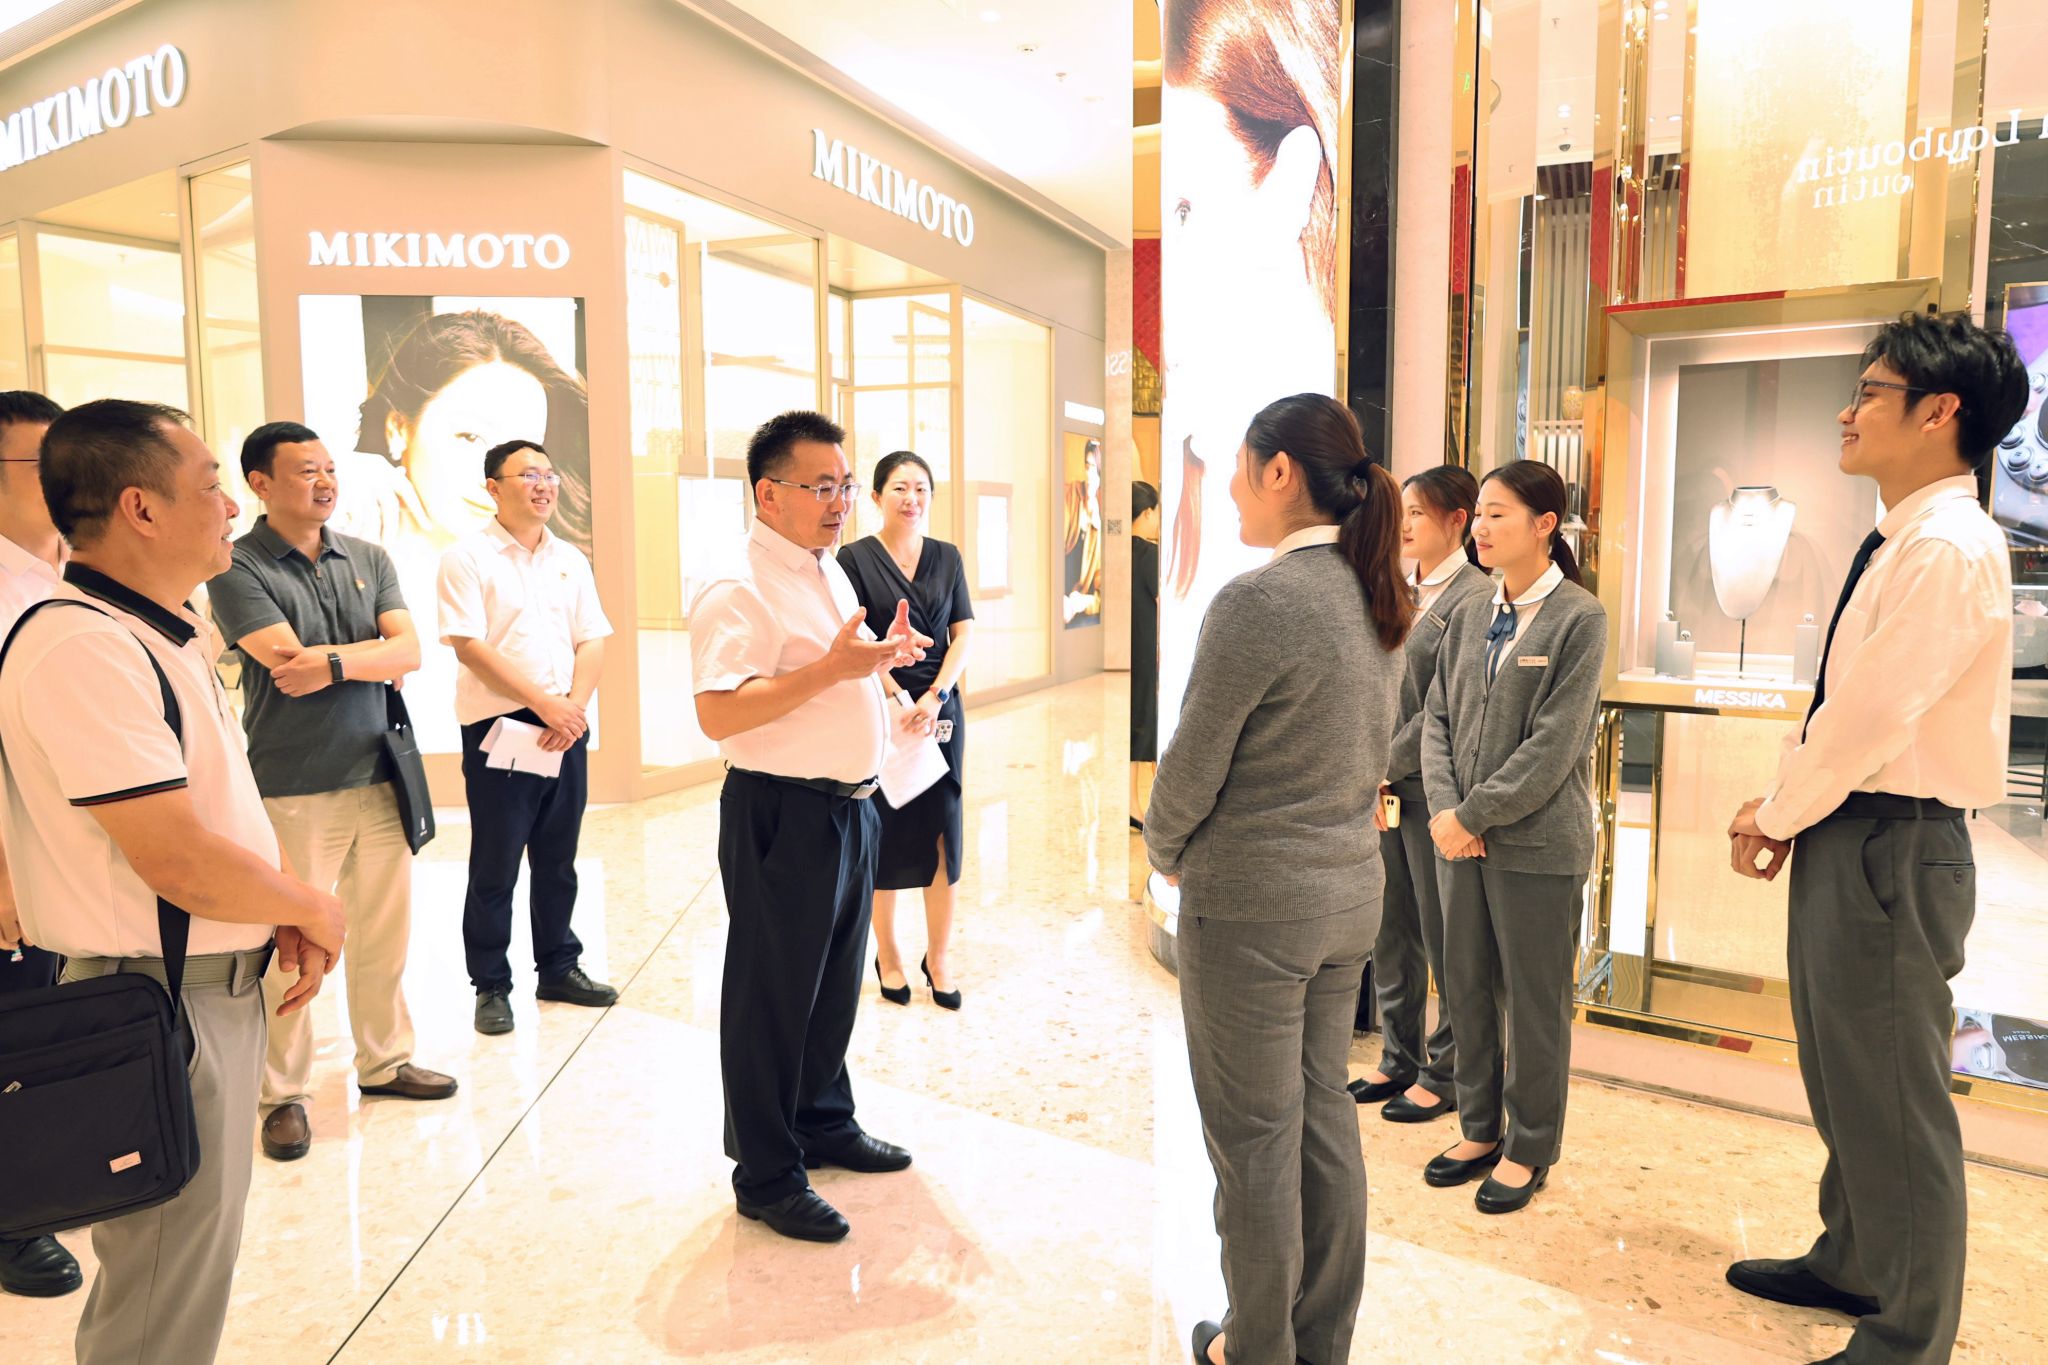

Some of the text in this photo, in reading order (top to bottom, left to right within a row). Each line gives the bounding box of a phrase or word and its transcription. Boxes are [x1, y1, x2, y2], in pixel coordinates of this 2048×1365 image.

[0, 44, 184, 172] MIKIMOTO
[812, 128, 974, 247] MIKIMOTO
[308, 231, 570, 269] MIKIMOTO
[1695, 688, 1786, 708] MESSIKA
